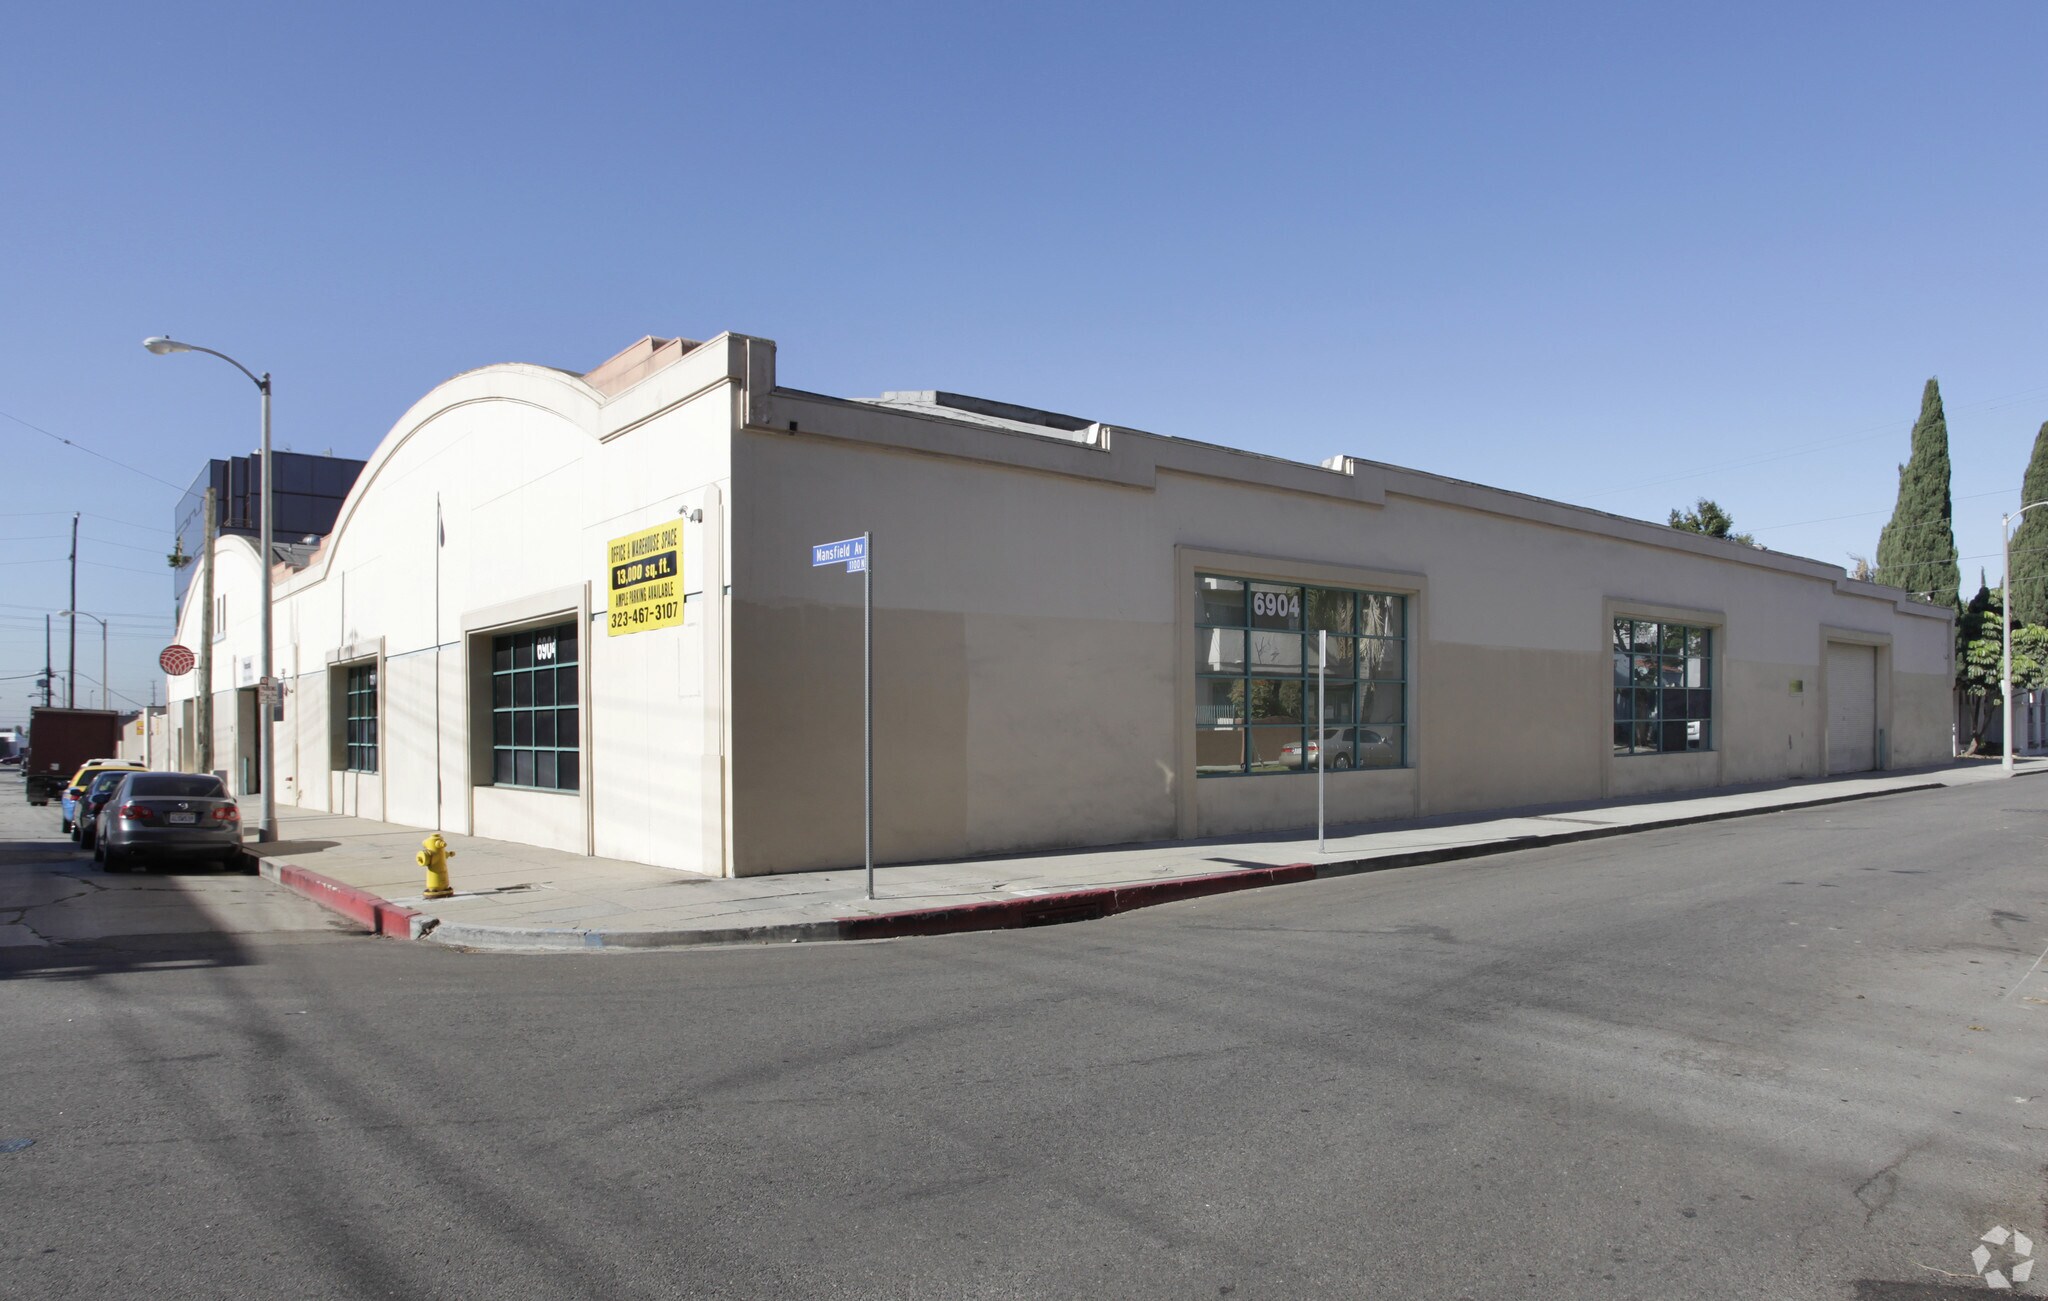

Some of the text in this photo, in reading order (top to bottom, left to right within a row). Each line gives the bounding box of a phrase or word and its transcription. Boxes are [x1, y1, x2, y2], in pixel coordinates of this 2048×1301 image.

[611, 543, 626, 563] OFFICE
[631, 533, 660, 557] WAREHOUSE
[661, 528, 677, 549] SPACE
[816, 542, 863, 562] Mansfield Av
[617, 557, 671, 585] 13,000 sq. ft.
[616, 581, 673, 608] AMPLE PARKING AVAILABLE
[1253, 592, 1300, 618] 6904
[611, 602, 678, 628] 323-467-3107
